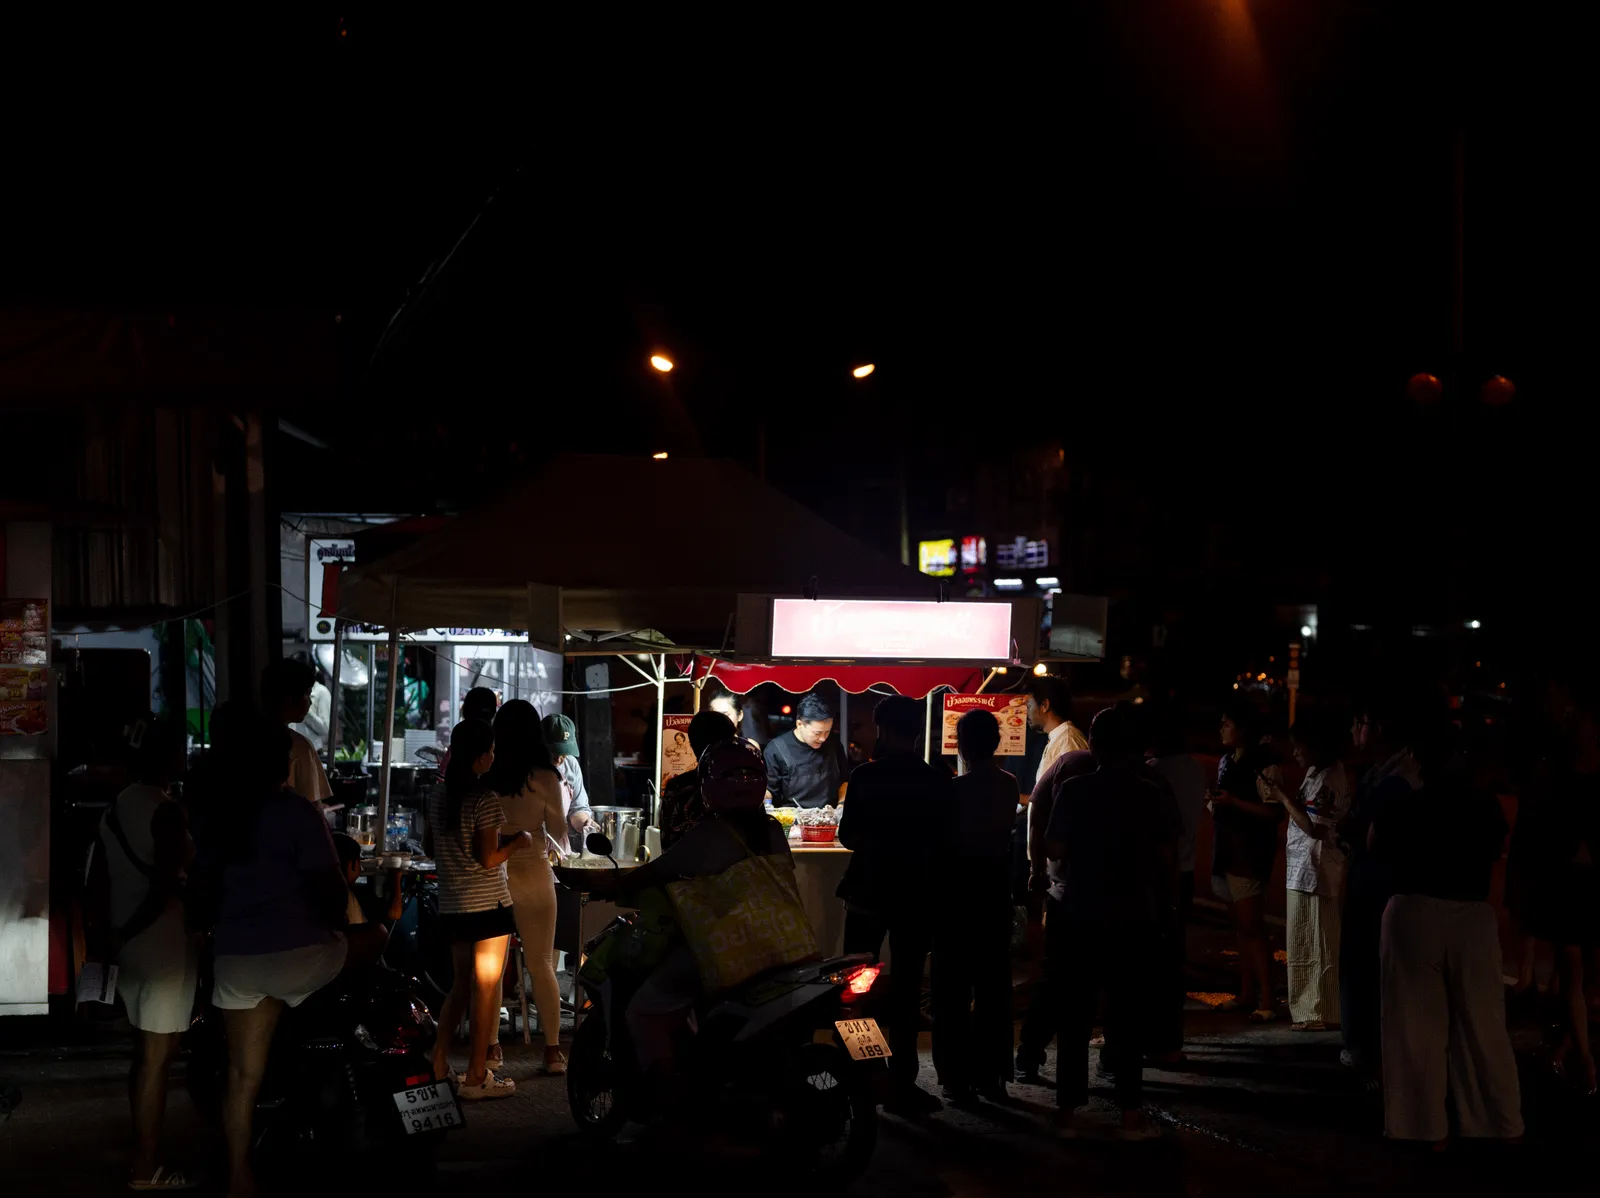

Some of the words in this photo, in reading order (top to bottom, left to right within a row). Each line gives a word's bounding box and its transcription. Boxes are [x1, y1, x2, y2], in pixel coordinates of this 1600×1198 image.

[563, 731, 570, 740] P
[859, 1044, 884, 1058] 189
[411, 1112, 454, 1132] 9416
